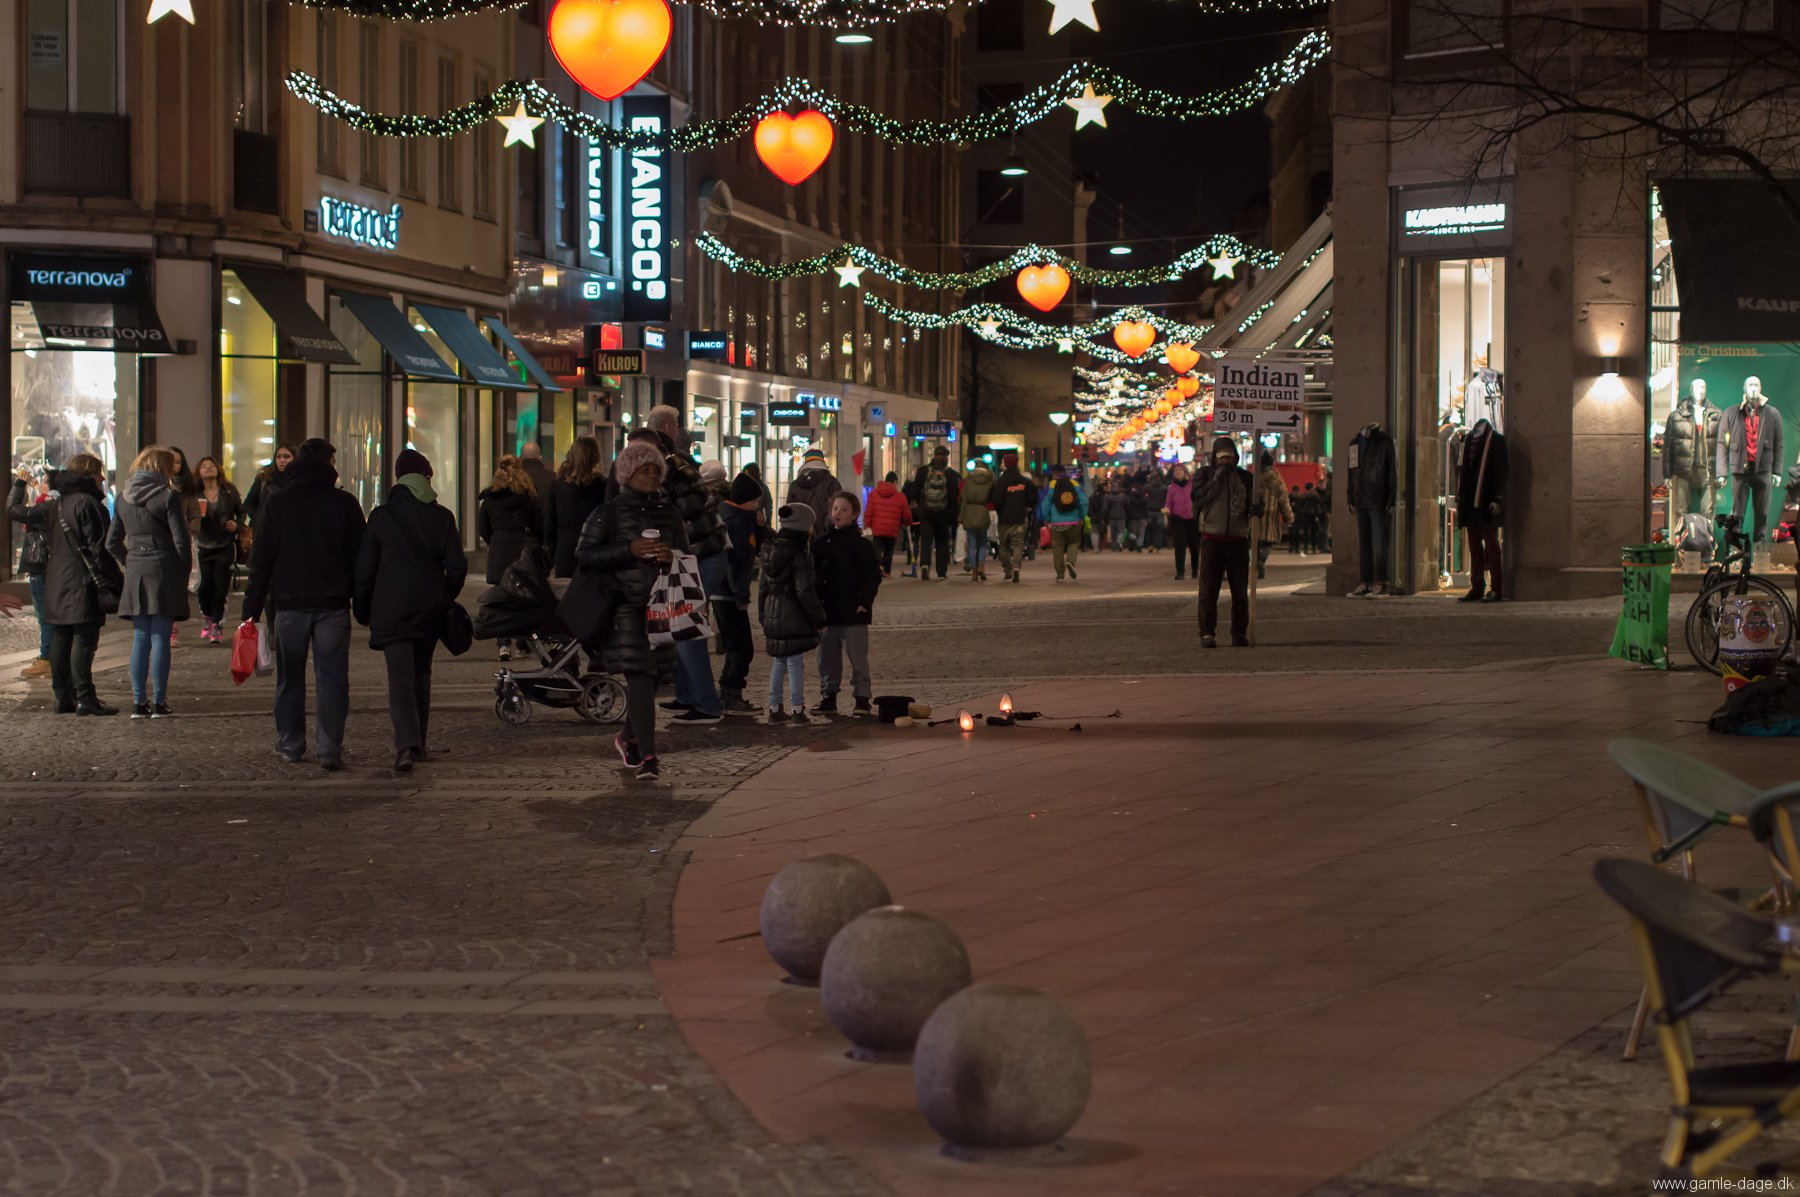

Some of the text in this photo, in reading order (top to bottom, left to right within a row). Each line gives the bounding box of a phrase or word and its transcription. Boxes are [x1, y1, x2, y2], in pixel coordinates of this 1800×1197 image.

[1221, 365, 1300, 388] Indian
[1220, 387, 1299, 401] restaurant
[1219, 411, 1254, 424] 30 m
